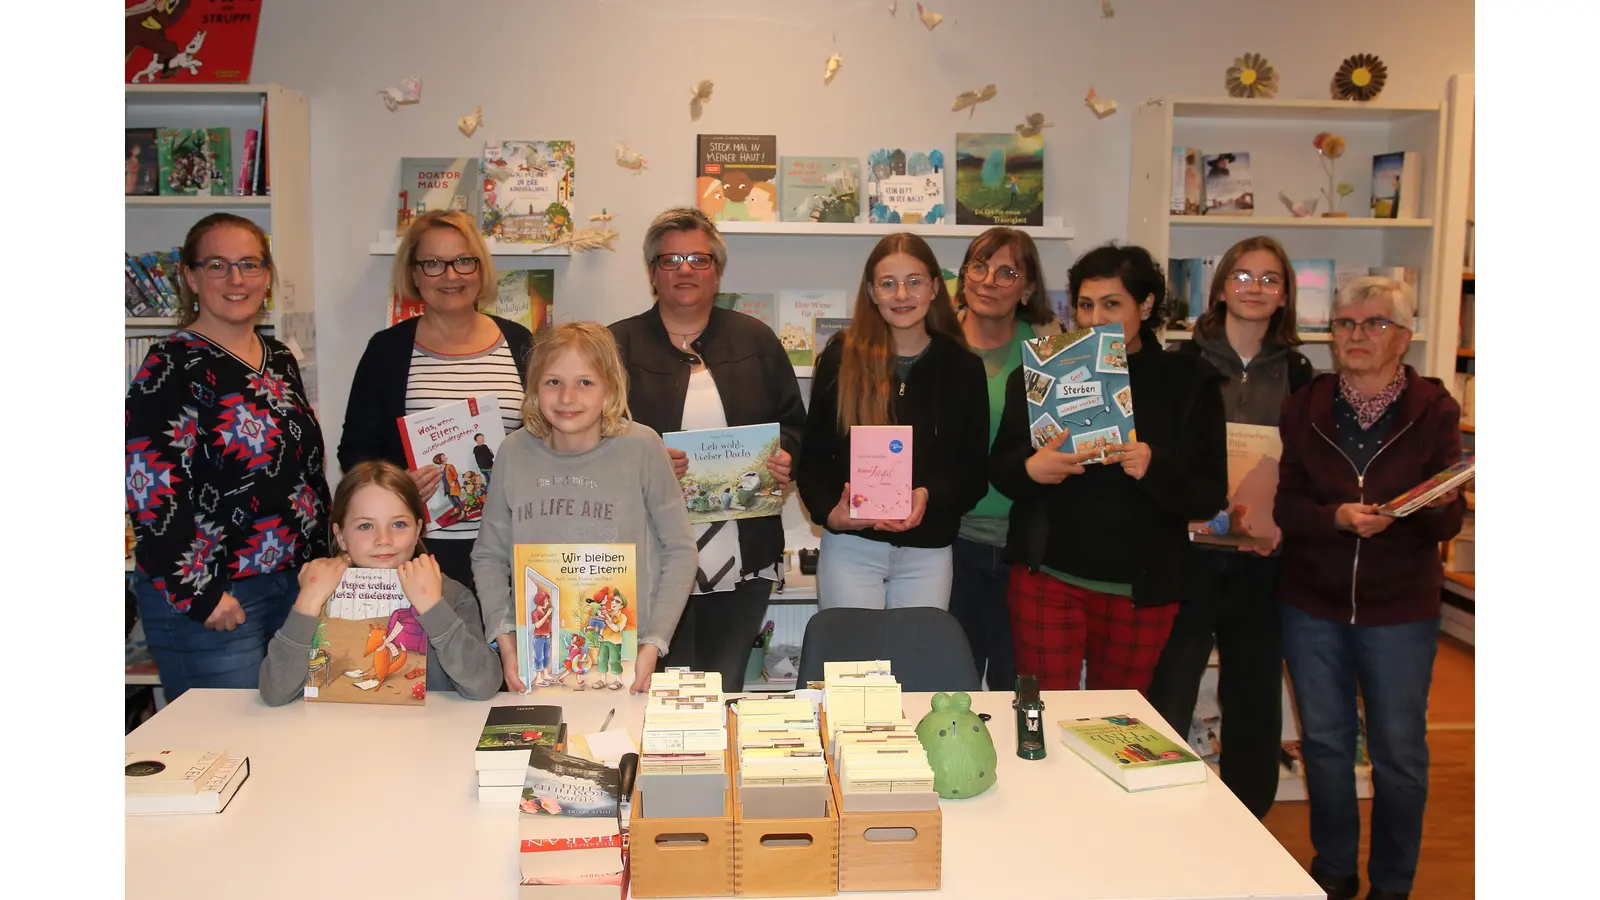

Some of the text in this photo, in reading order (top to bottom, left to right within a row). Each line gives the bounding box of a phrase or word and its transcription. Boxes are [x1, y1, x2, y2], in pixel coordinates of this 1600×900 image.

[202, 13, 252, 24] STRUPPI
[709, 142, 761, 152] STECK MAL IN
[706, 152, 766, 163] MEINER HAUT!
[418, 171, 461, 180] DOKTOR
[418, 181, 449, 189] MAUS
[1063, 385, 1096, 396] Sterben
[417, 424, 437, 436] Was,
[437, 417, 455, 427] wenn
[429, 425, 460, 441] Eltern
[422, 424, 479, 455] auseinandergehen?
[701, 442, 718, 452] Leb
[694, 449, 752, 461] lieber Dachs
[518, 498, 615, 522] IN LIFE ARE
[561, 552, 581, 563] Wir
[585, 553, 625, 563] bleiben
[560, 565, 628, 575] eure Eltern!
[341, 581, 397, 592] Papa wohnt
[358, 592, 404, 600] anderswo
[556, 794, 595, 802] STURM
[527, 835, 613, 847] HARAN
